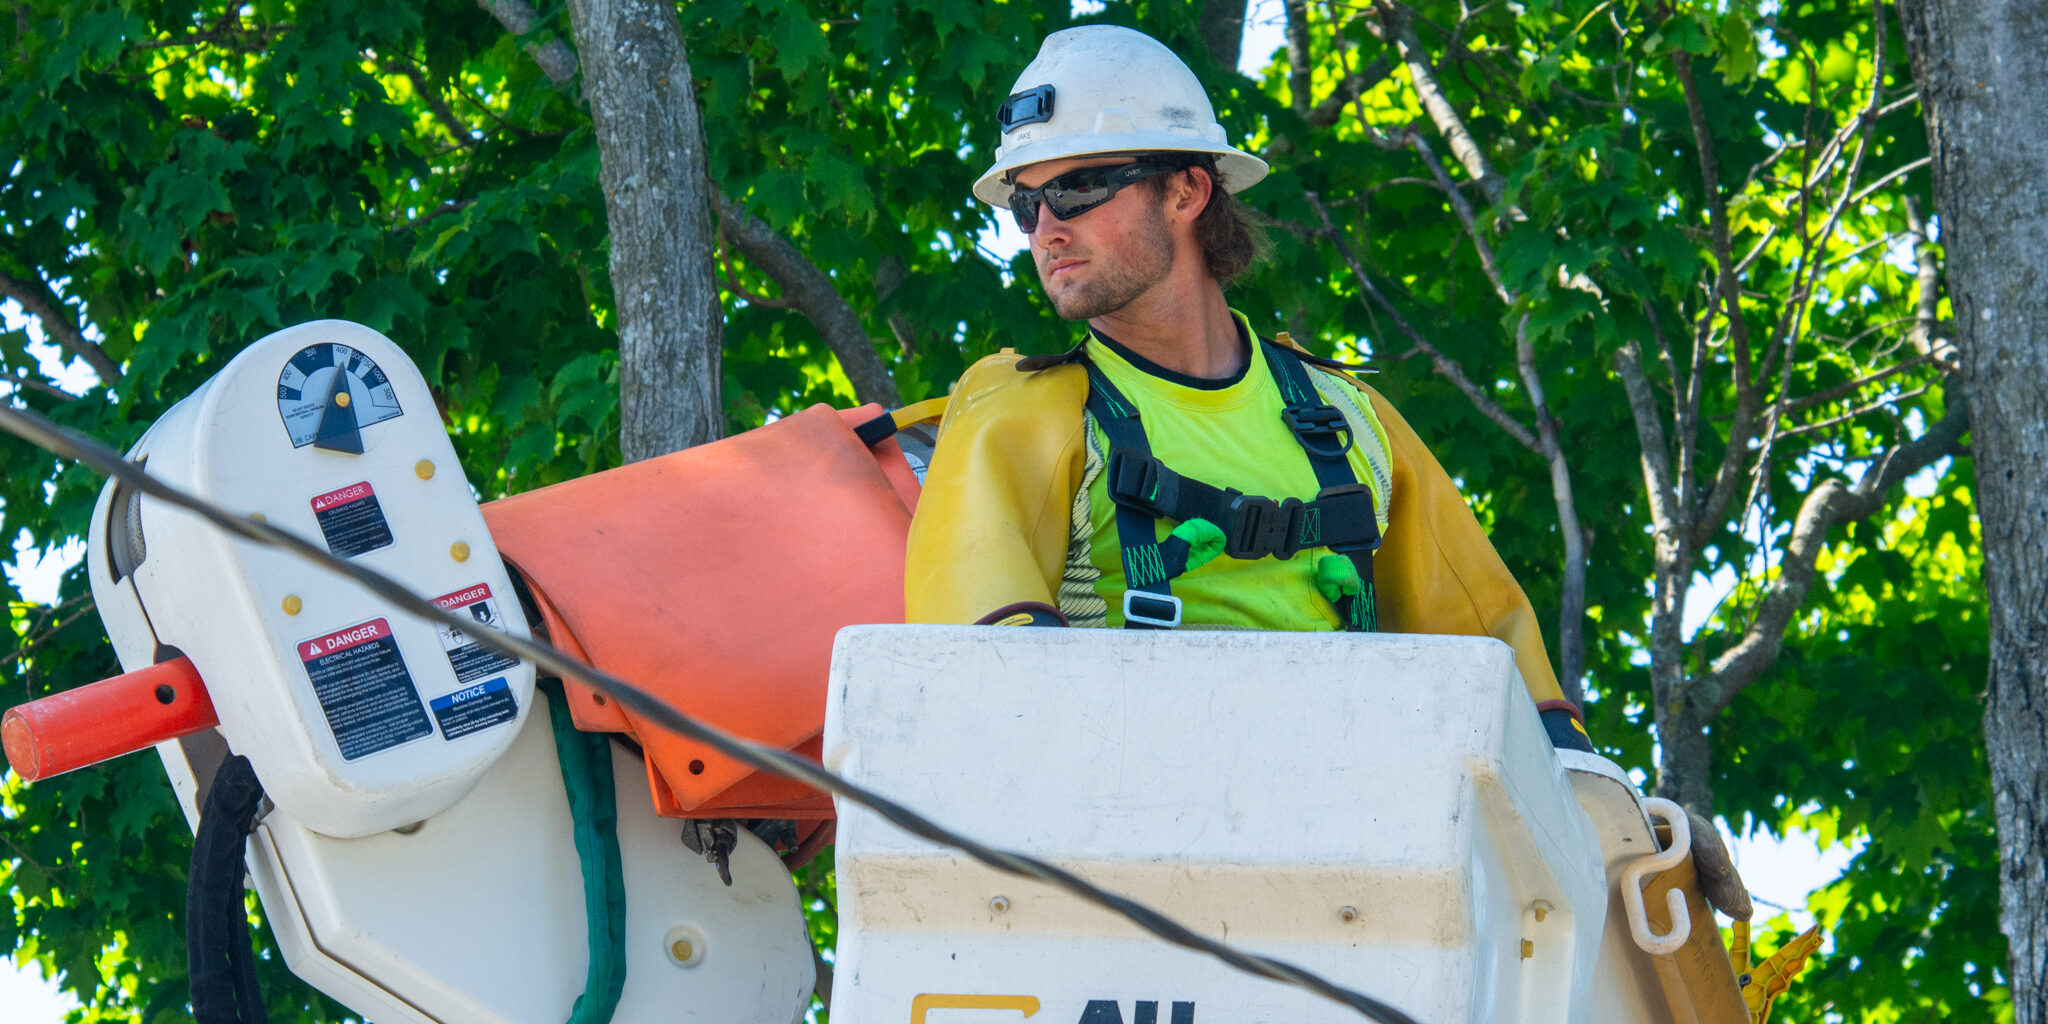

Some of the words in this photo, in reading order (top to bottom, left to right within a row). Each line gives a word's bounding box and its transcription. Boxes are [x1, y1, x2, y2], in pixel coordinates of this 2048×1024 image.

[1017, 131, 1032, 141] JAKE
[304, 347, 317, 358] 350
[335, 346, 348, 355] 400
[352, 352, 362, 361] 500
[362, 357, 374, 369] 750
[373, 368, 385, 382] 1000
[384, 388, 393, 400] 500
[325, 485, 364, 505] DANGER
[440, 588, 486, 609] DANGER
[325, 625, 379, 650] DANGER
[320, 651, 352, 665] ELECTRICAL
[353, 642, 380, 654] HAZARDS
[451, 685, 486, 704] NOTICE
